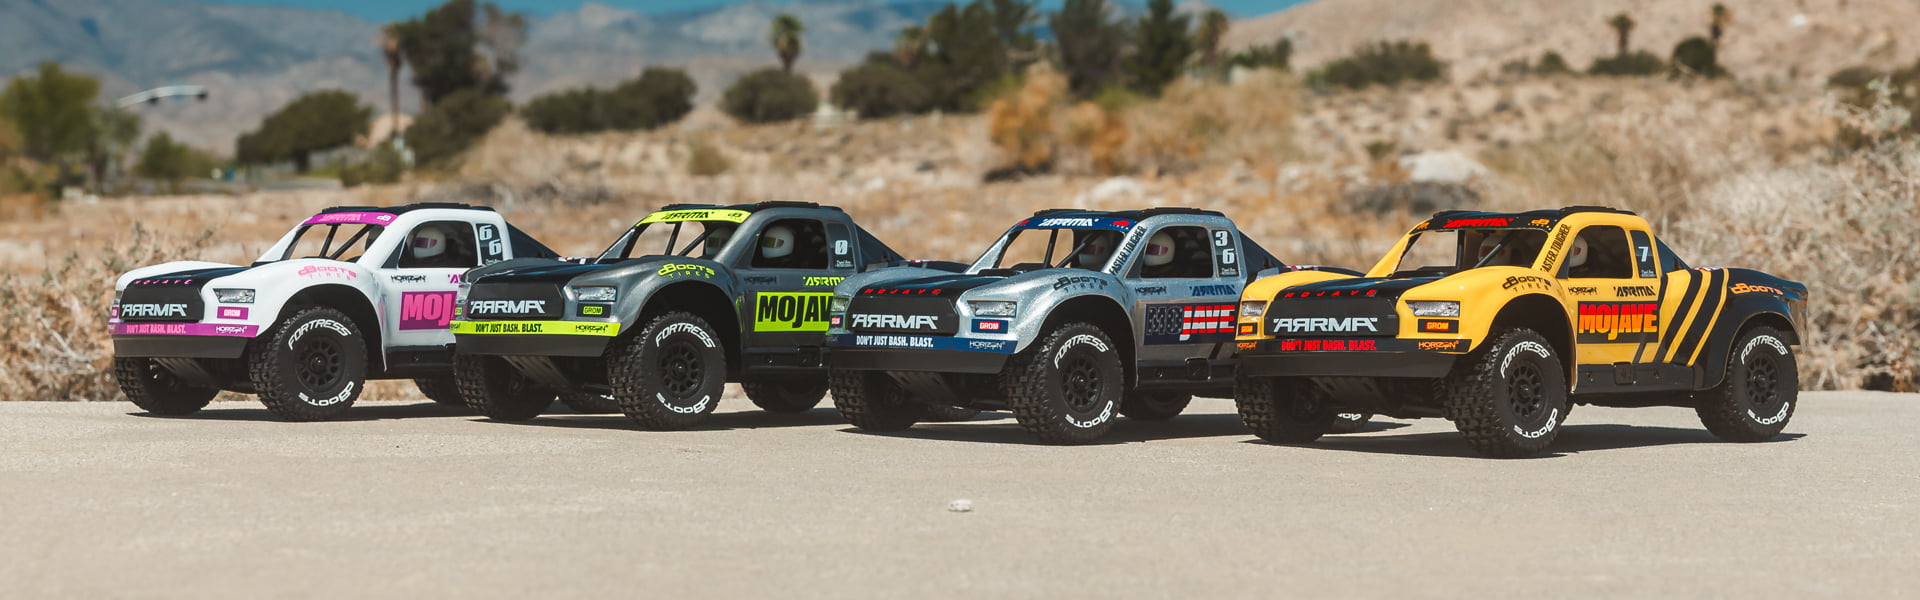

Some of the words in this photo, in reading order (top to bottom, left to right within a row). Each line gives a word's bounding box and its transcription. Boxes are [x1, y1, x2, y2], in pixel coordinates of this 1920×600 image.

[480, 225, 492, 240] 6
[1215, 231, 1228, 247] 3
[489, 239, 501, 256] 6
[1222, 248, 1235, 264] 6
[1638, 246, 1649, 262] 7
[1540, 250, 1558, 272] ASTER.
[803, 276, 845, 286] ARRM
[402, 293, 456, 326] MOJ
[757, 295, 834, 329] MOJAV
[475, 324, 489, 332] DON'T
[490, 324, 502, 332] JUST
[979, 322, 999, 330] GROM
[1146, 305, 1235, 341] MOJAVE
[1427, 322, 1449, 330] GROM
[1579, 304, 1657, 340] MOJAVE
[288, 319, 351, 351] FORTRESS
[656, 322, 716, 348] FORTRESS
[856, 335, 873, 345] DON'T
[874, 335, 888, 346] JUST
[889, 336, 908, 346] BASH.
[909, 337, 934, 348] BLAST.
[1054, 334, 1109, 369] FORTRESS
[1741, 334, 1788, 365] FORTRESS
[1500, 341, 1551, 379] FORTRESS
